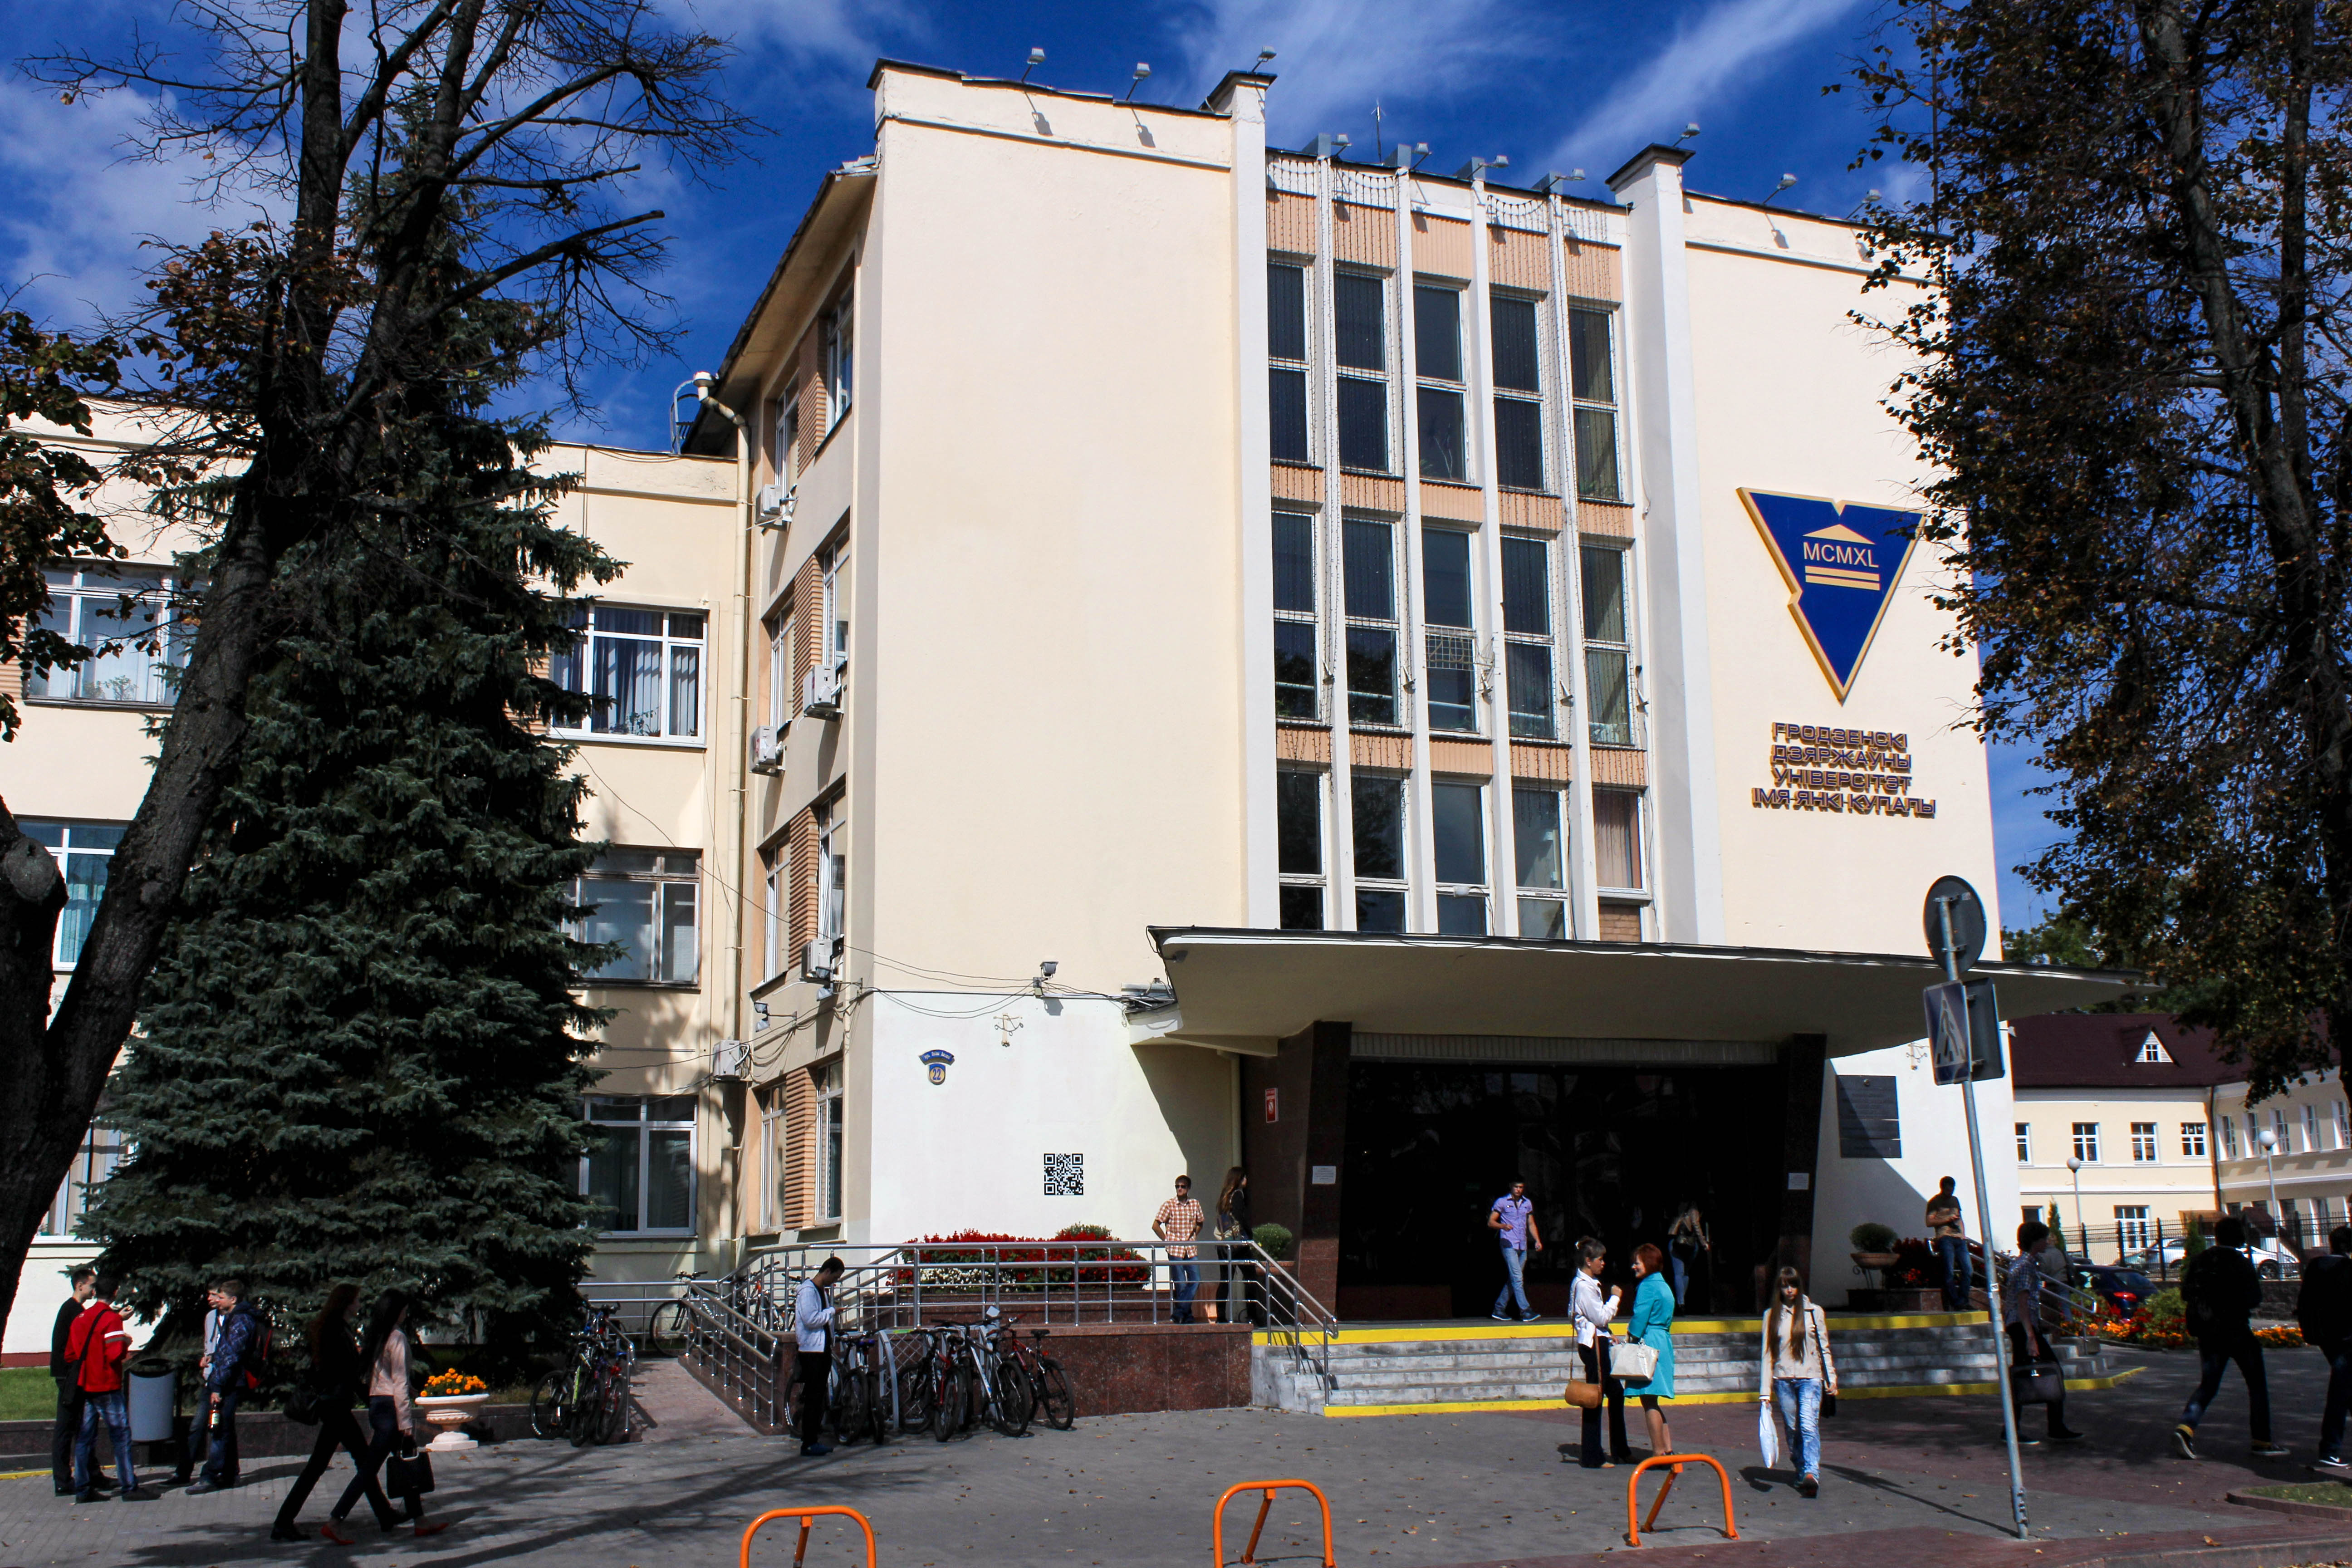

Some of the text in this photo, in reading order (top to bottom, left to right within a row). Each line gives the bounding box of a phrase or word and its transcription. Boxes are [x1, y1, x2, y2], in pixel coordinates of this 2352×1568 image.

[1803, 542, 1879, 568] MCMXL
[1772, 722, 1907, 751] ГРОДЗЕНСКІ
[1771, 745, 1911, 770] ДЗЯРЖАЎНЫ
[1771, 767, 1912, 794] УНІВЕРСІТЭТ
[1751, 788, 1936, 816] ІМЯ ЯНКІ КУПАЛЫ
[933, 1068, 941, 1080] 22
